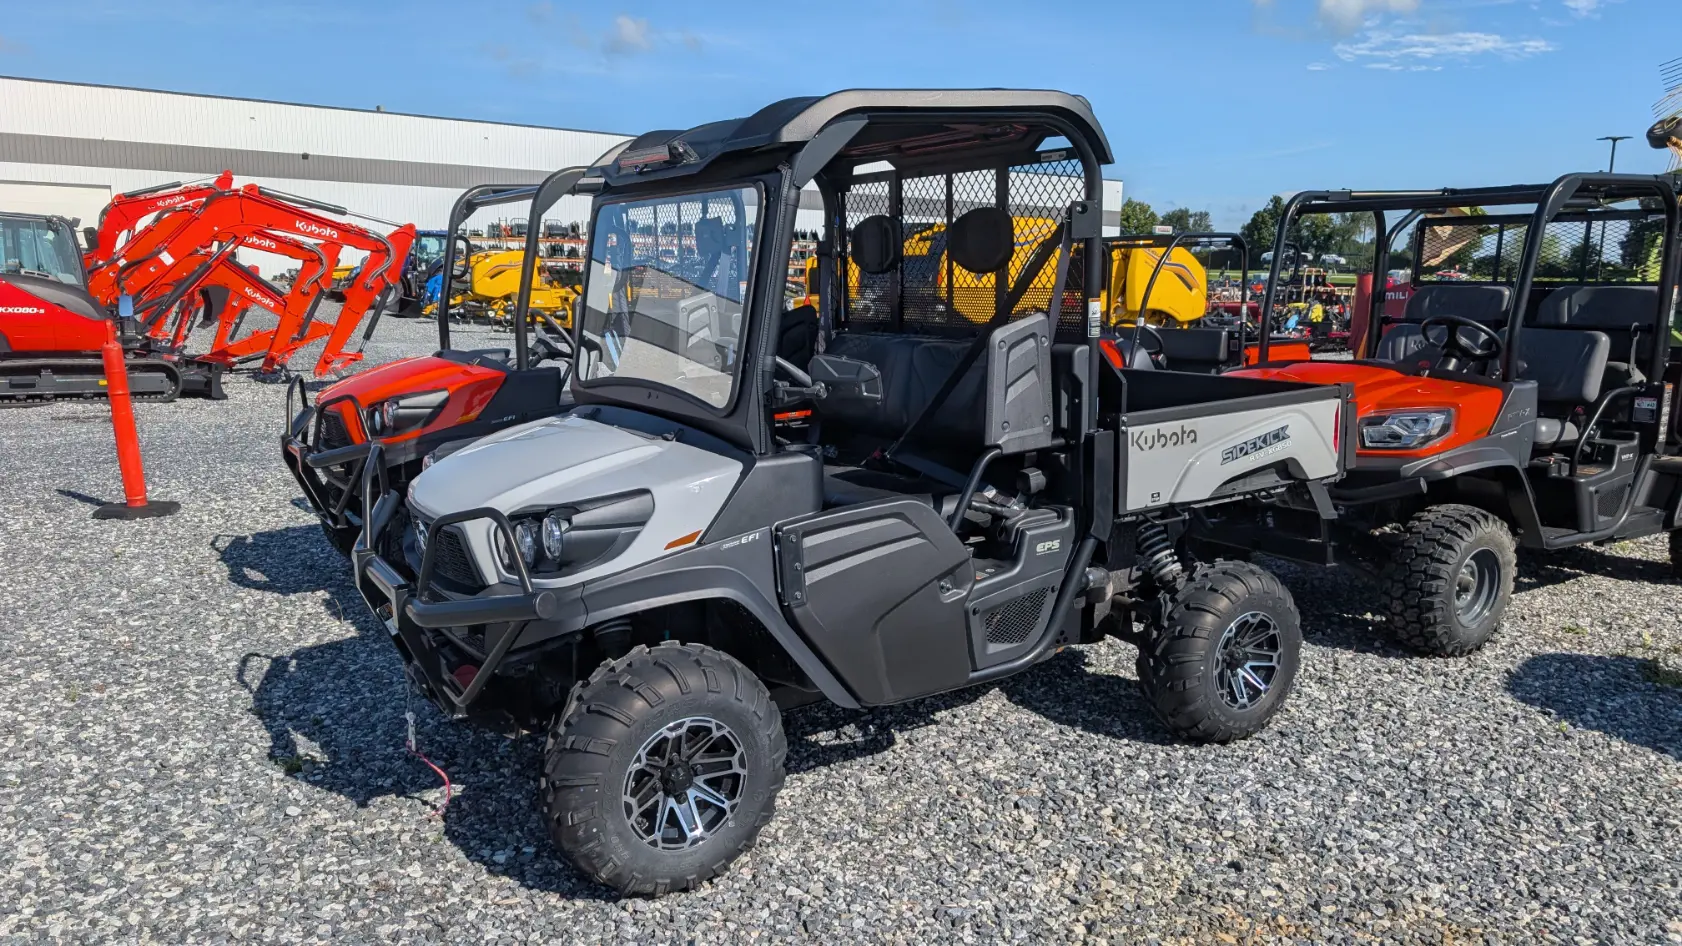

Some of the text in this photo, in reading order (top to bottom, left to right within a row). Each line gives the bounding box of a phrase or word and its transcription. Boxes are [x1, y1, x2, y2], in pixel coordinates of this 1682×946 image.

[156, 195, 186, 207] Kubota
[295, 219, 338, 239] Kubota
[244, 286, 275, 308] Kubota
[1130, 424, 1198, 452] Kubota
[1220, 424, 1290, 466] SIDEKICK
[741, 532, 759, 544] EFI
[1036, 539, 1061, 553] EPS
